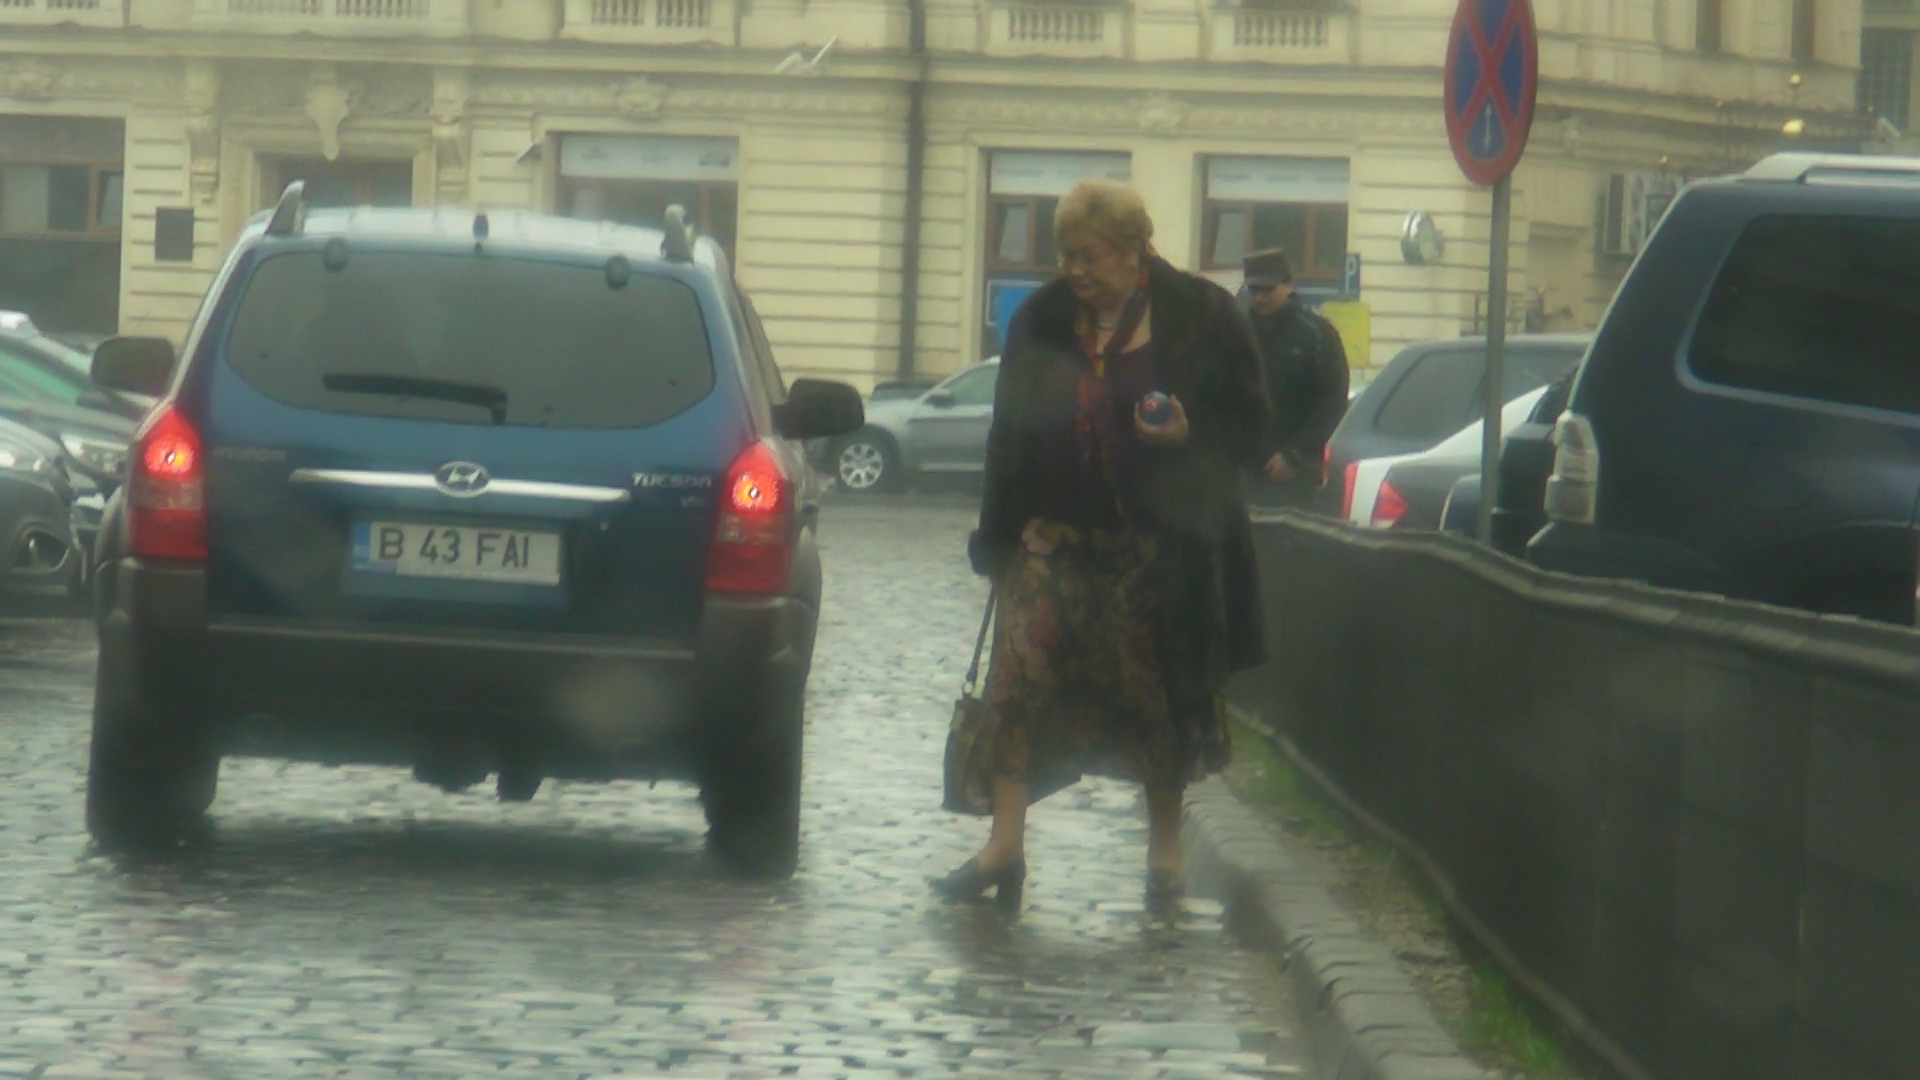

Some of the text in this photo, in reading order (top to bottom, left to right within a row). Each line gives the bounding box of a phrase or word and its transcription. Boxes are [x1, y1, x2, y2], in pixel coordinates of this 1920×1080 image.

[1345, 256, 1357, 295] P
[379, 527, 530, 568] B 43 FAI
